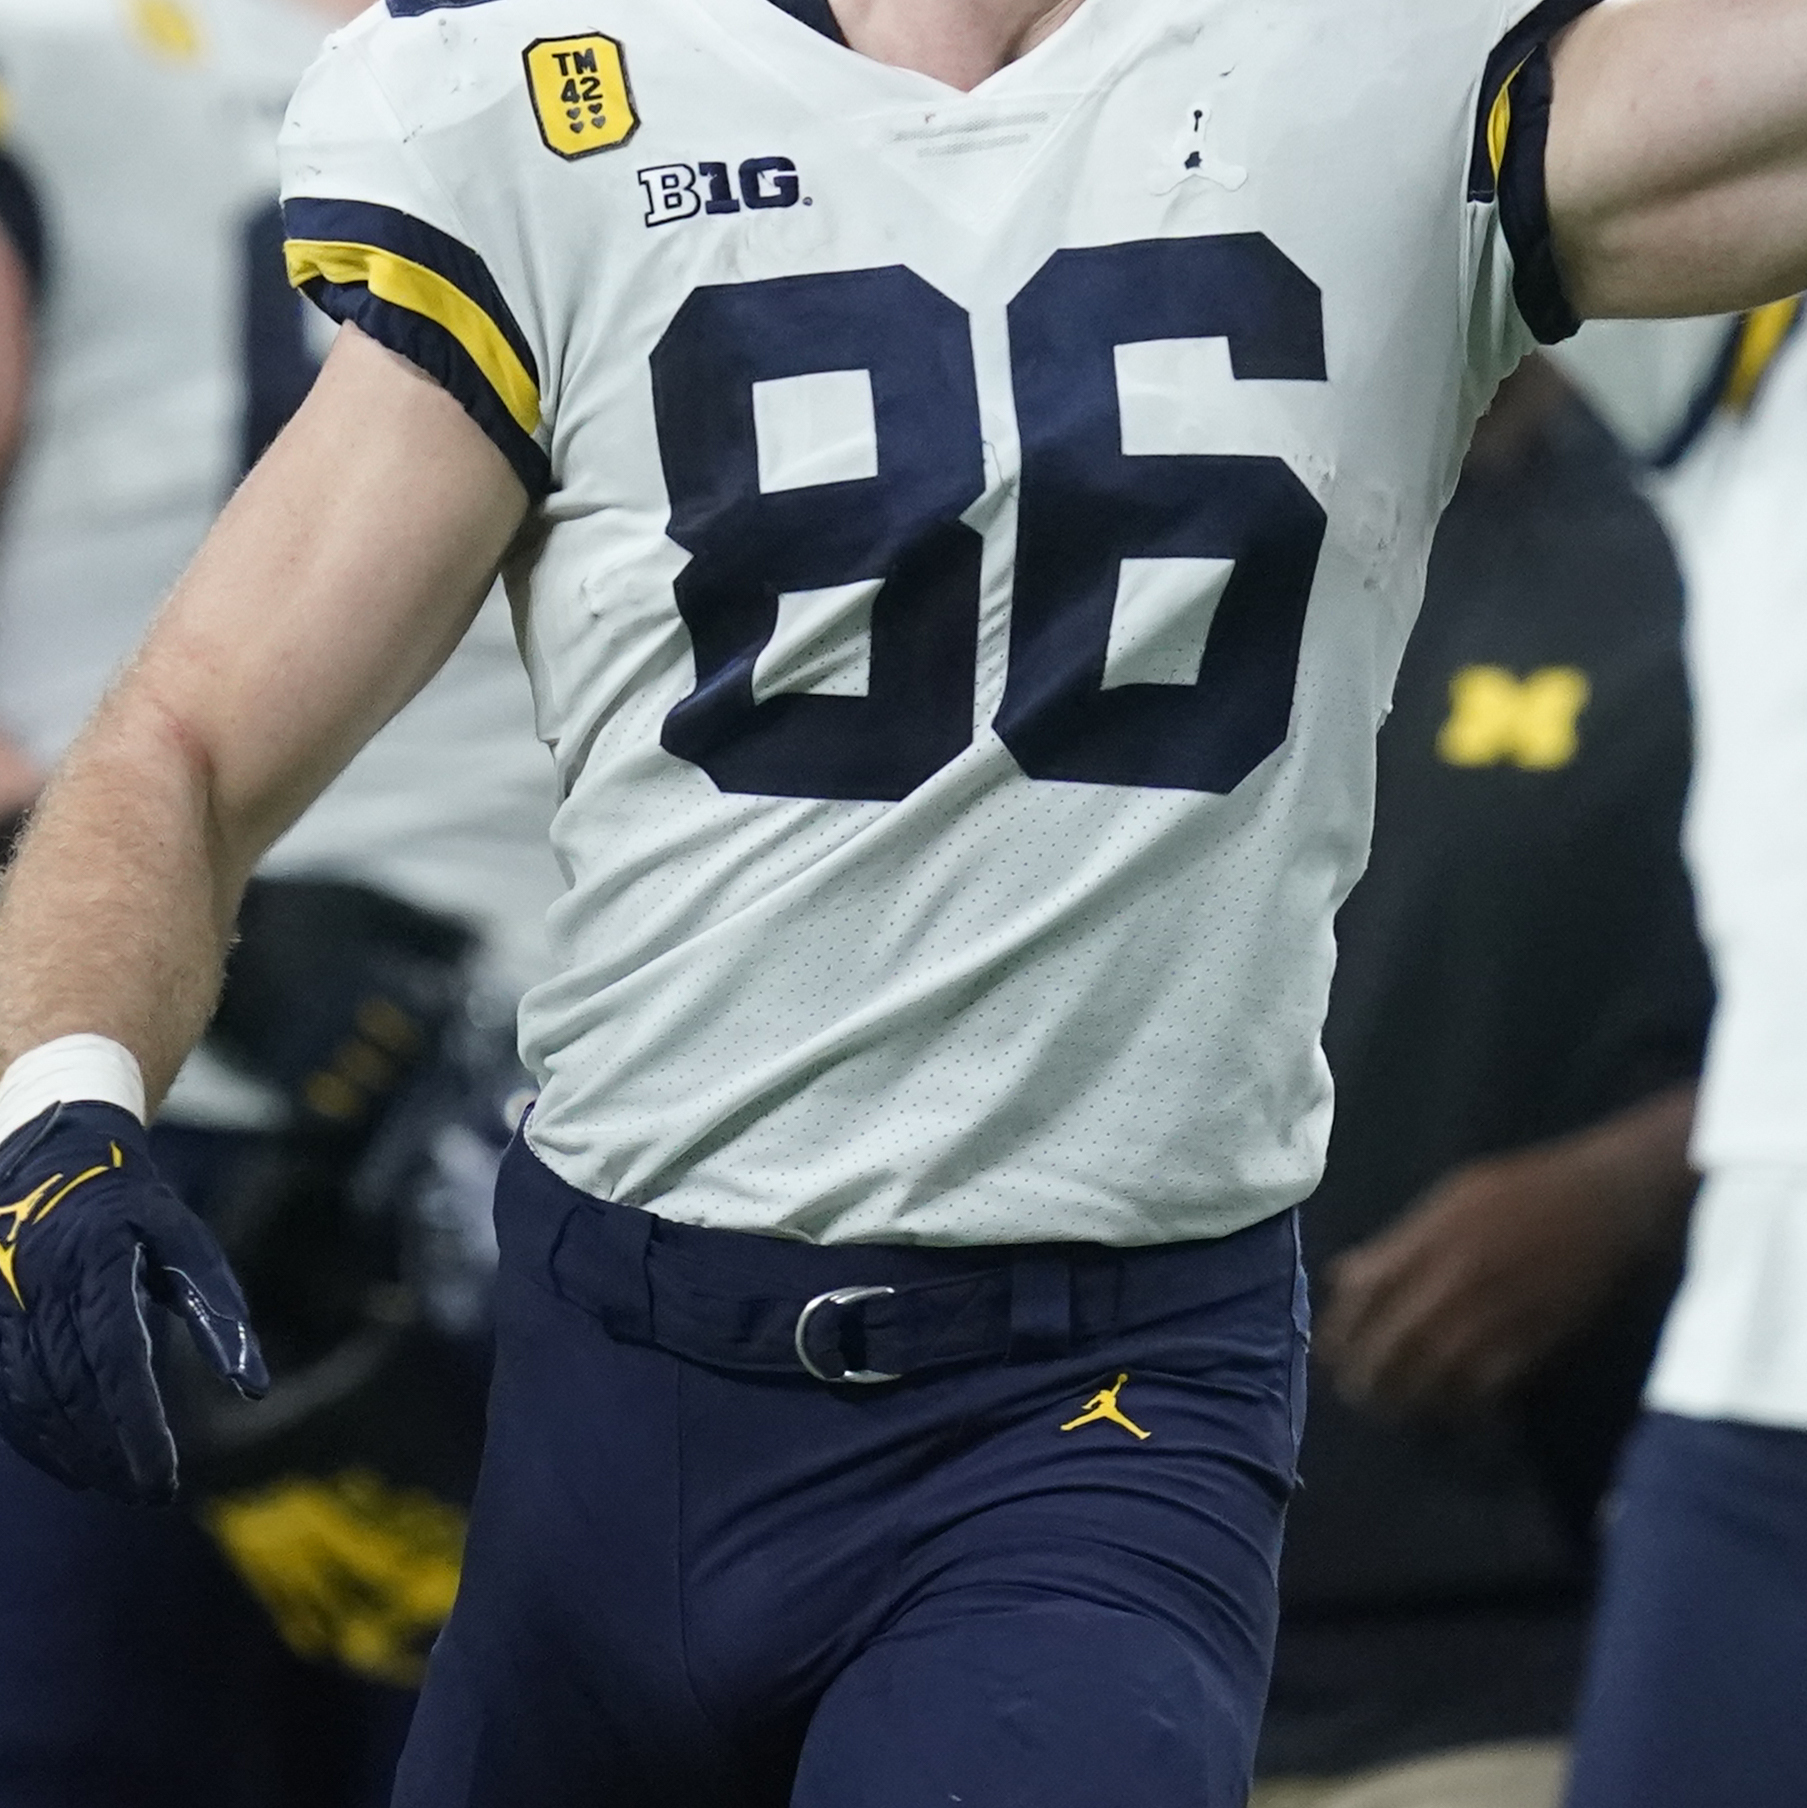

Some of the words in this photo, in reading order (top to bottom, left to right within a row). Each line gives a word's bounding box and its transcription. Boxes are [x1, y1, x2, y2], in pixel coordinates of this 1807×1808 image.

[552, 47, 598, 76] TM
[561, 76, 604, 104] 42
[648, 231, 1329, 802] 86
[1442, 667, 1584, 768] M
